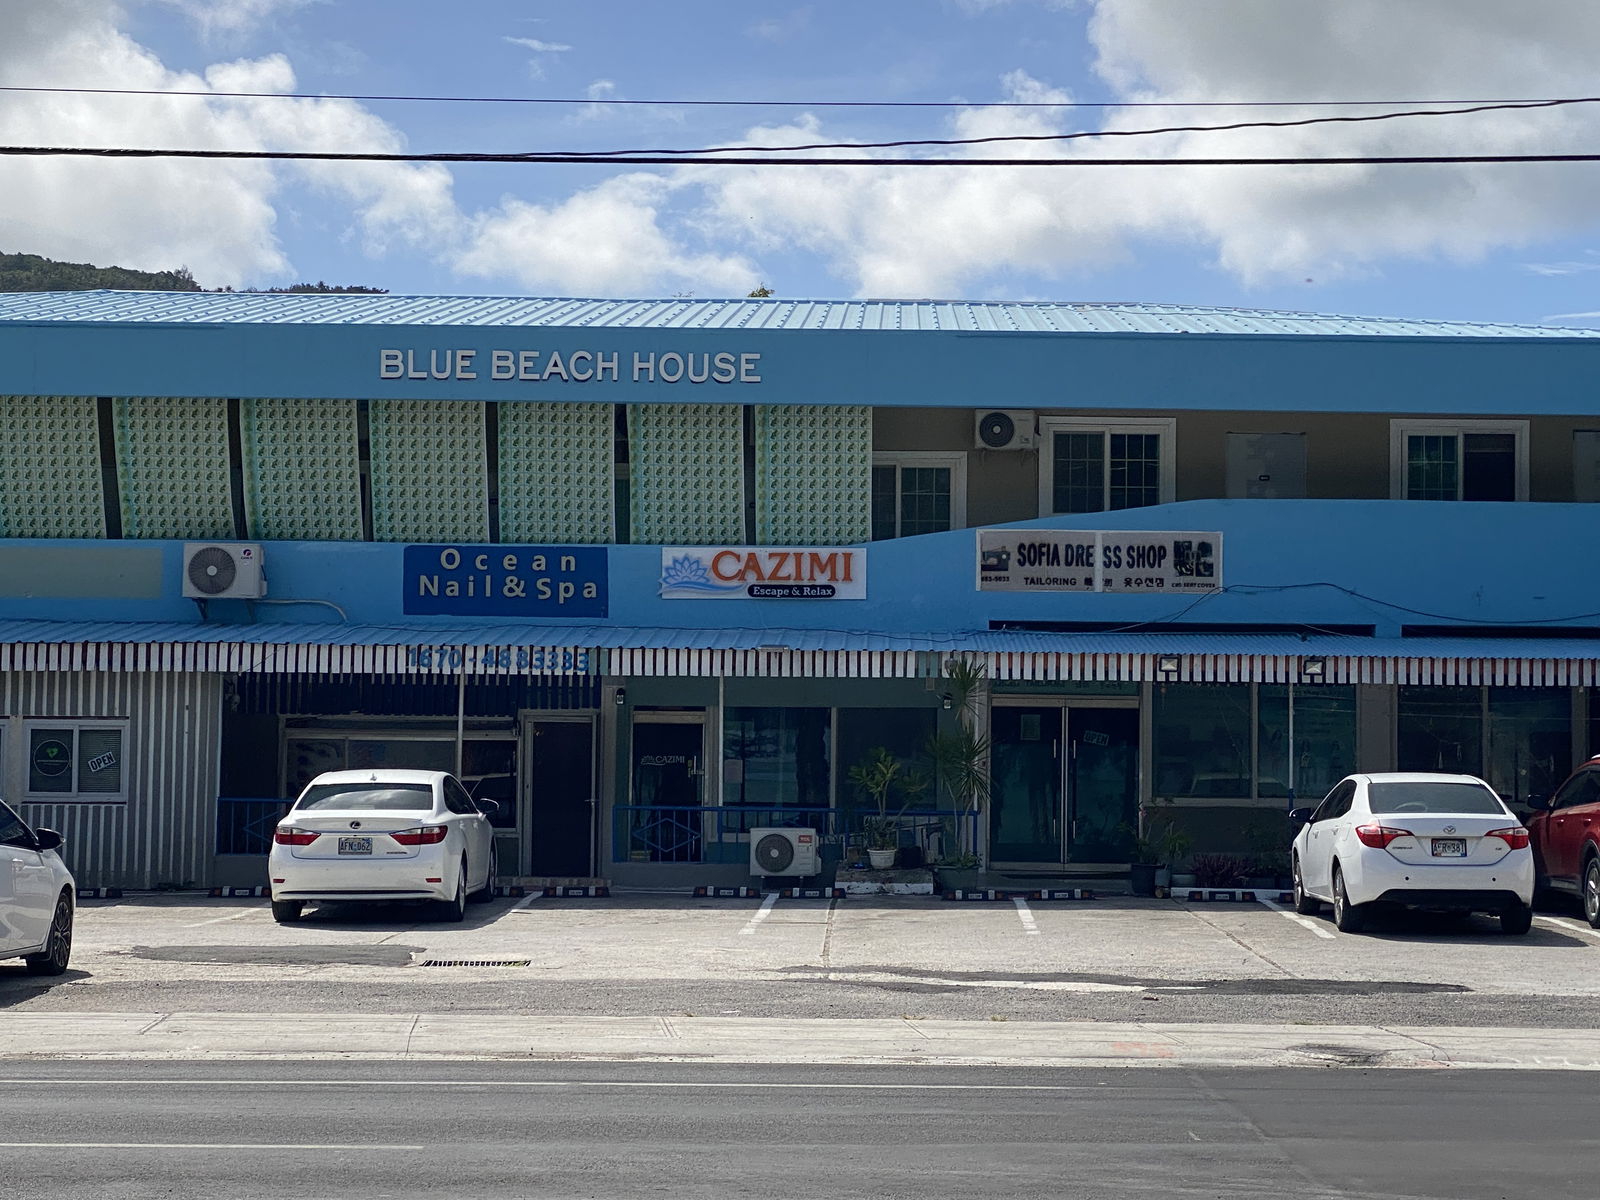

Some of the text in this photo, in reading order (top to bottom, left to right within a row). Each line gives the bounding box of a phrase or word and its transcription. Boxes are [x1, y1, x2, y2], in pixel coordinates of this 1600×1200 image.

[380, 349, 761, 383] BLUE BEACH HOUSE
[440, 548, 576, 572] Ocean
[711, 550, 854, 582] CAZIMI
[1017, 542, 1167, 569] SOFIA DRESS SHOP
[753, 586, 833, 598] Escape & Relax
[1023, 577, 1077, 586] TAILORING
[90, 752, 114, 771] OPEN
[655, 755, 685, 763] CAZIMI
